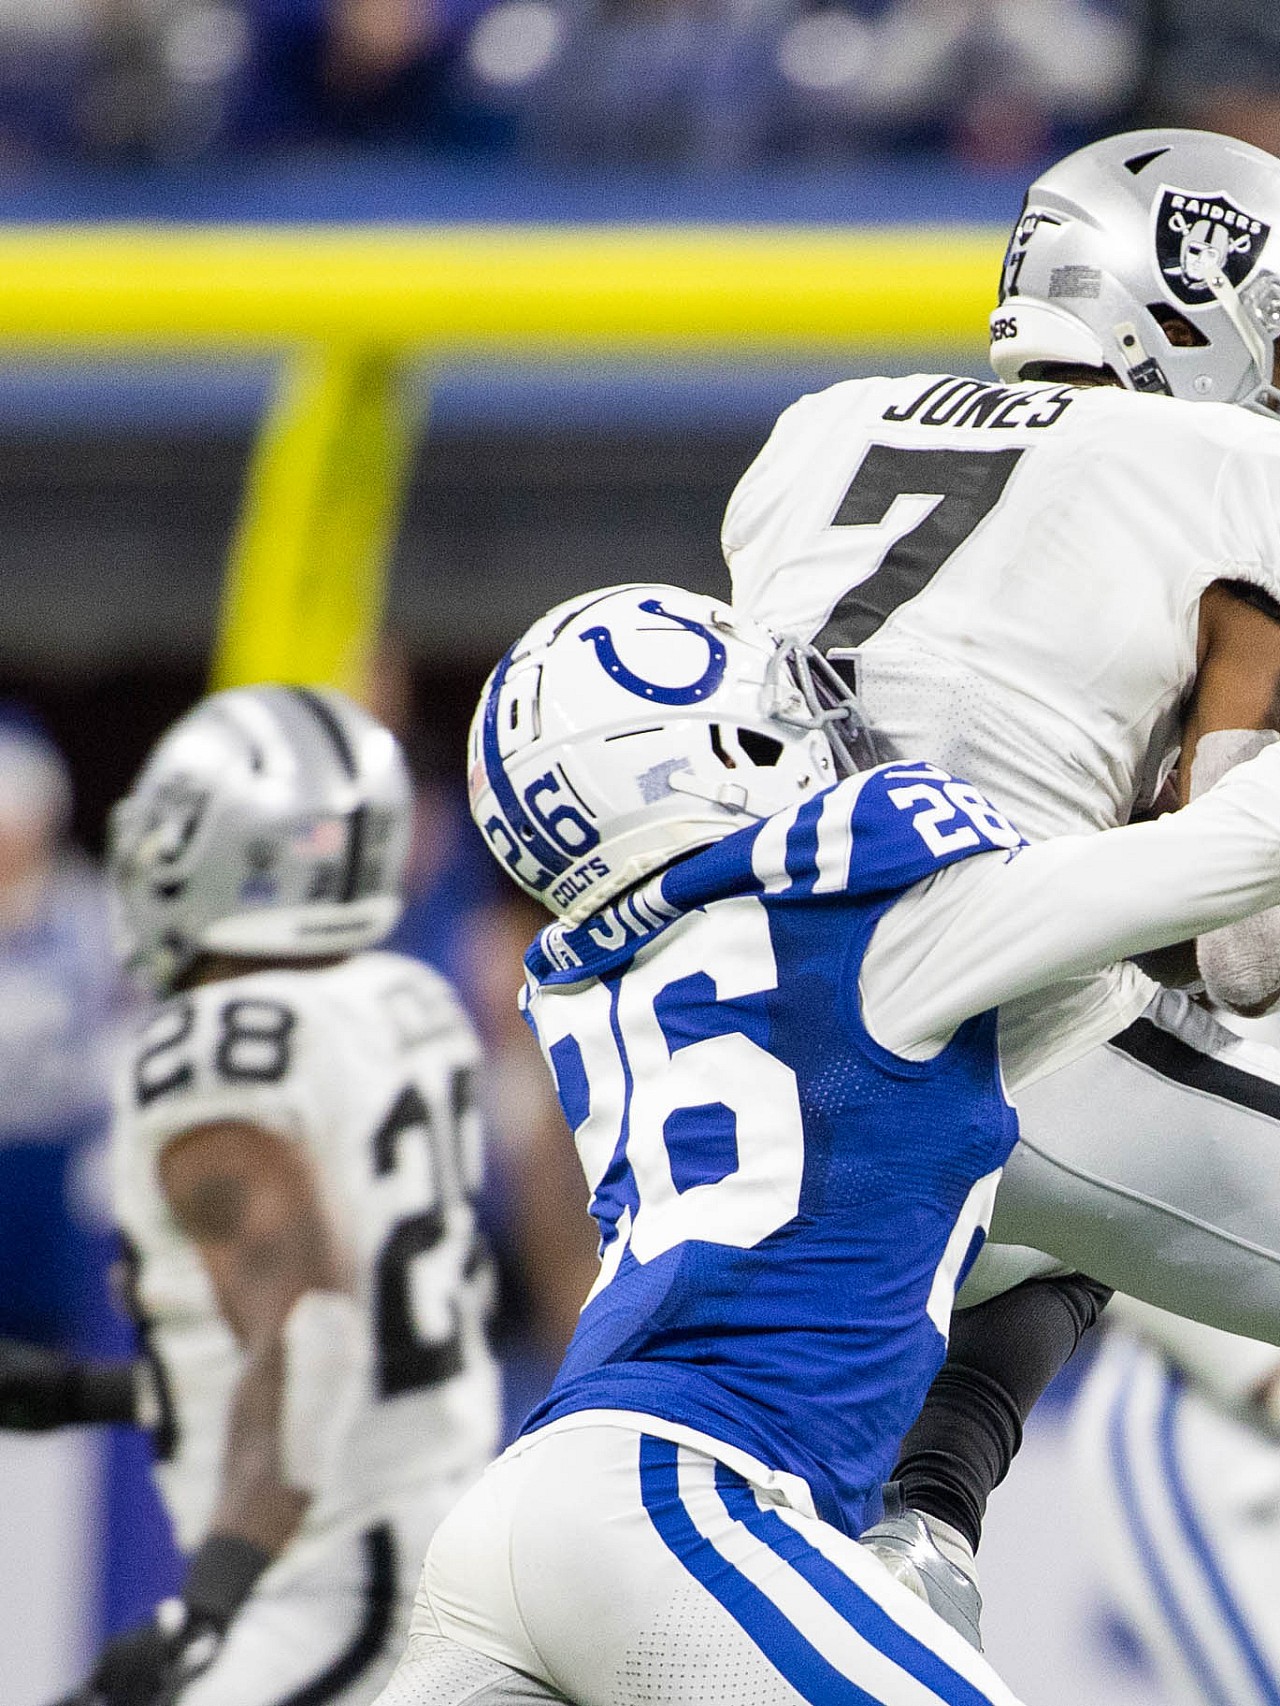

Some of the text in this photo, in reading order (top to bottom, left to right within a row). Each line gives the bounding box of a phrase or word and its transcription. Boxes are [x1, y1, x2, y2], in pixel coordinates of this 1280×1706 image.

[1171, 195, 1261, 235] RAIDERS
[990, 316, 1018, 344] ERS
[882, 376, 1074, 429] JONES
[810, 444, 1026, 696] 7
[485, 771, 601, 891] 26
[551, 856, 610, 909] COLTS
[134, 998, 297, 1108] 28
